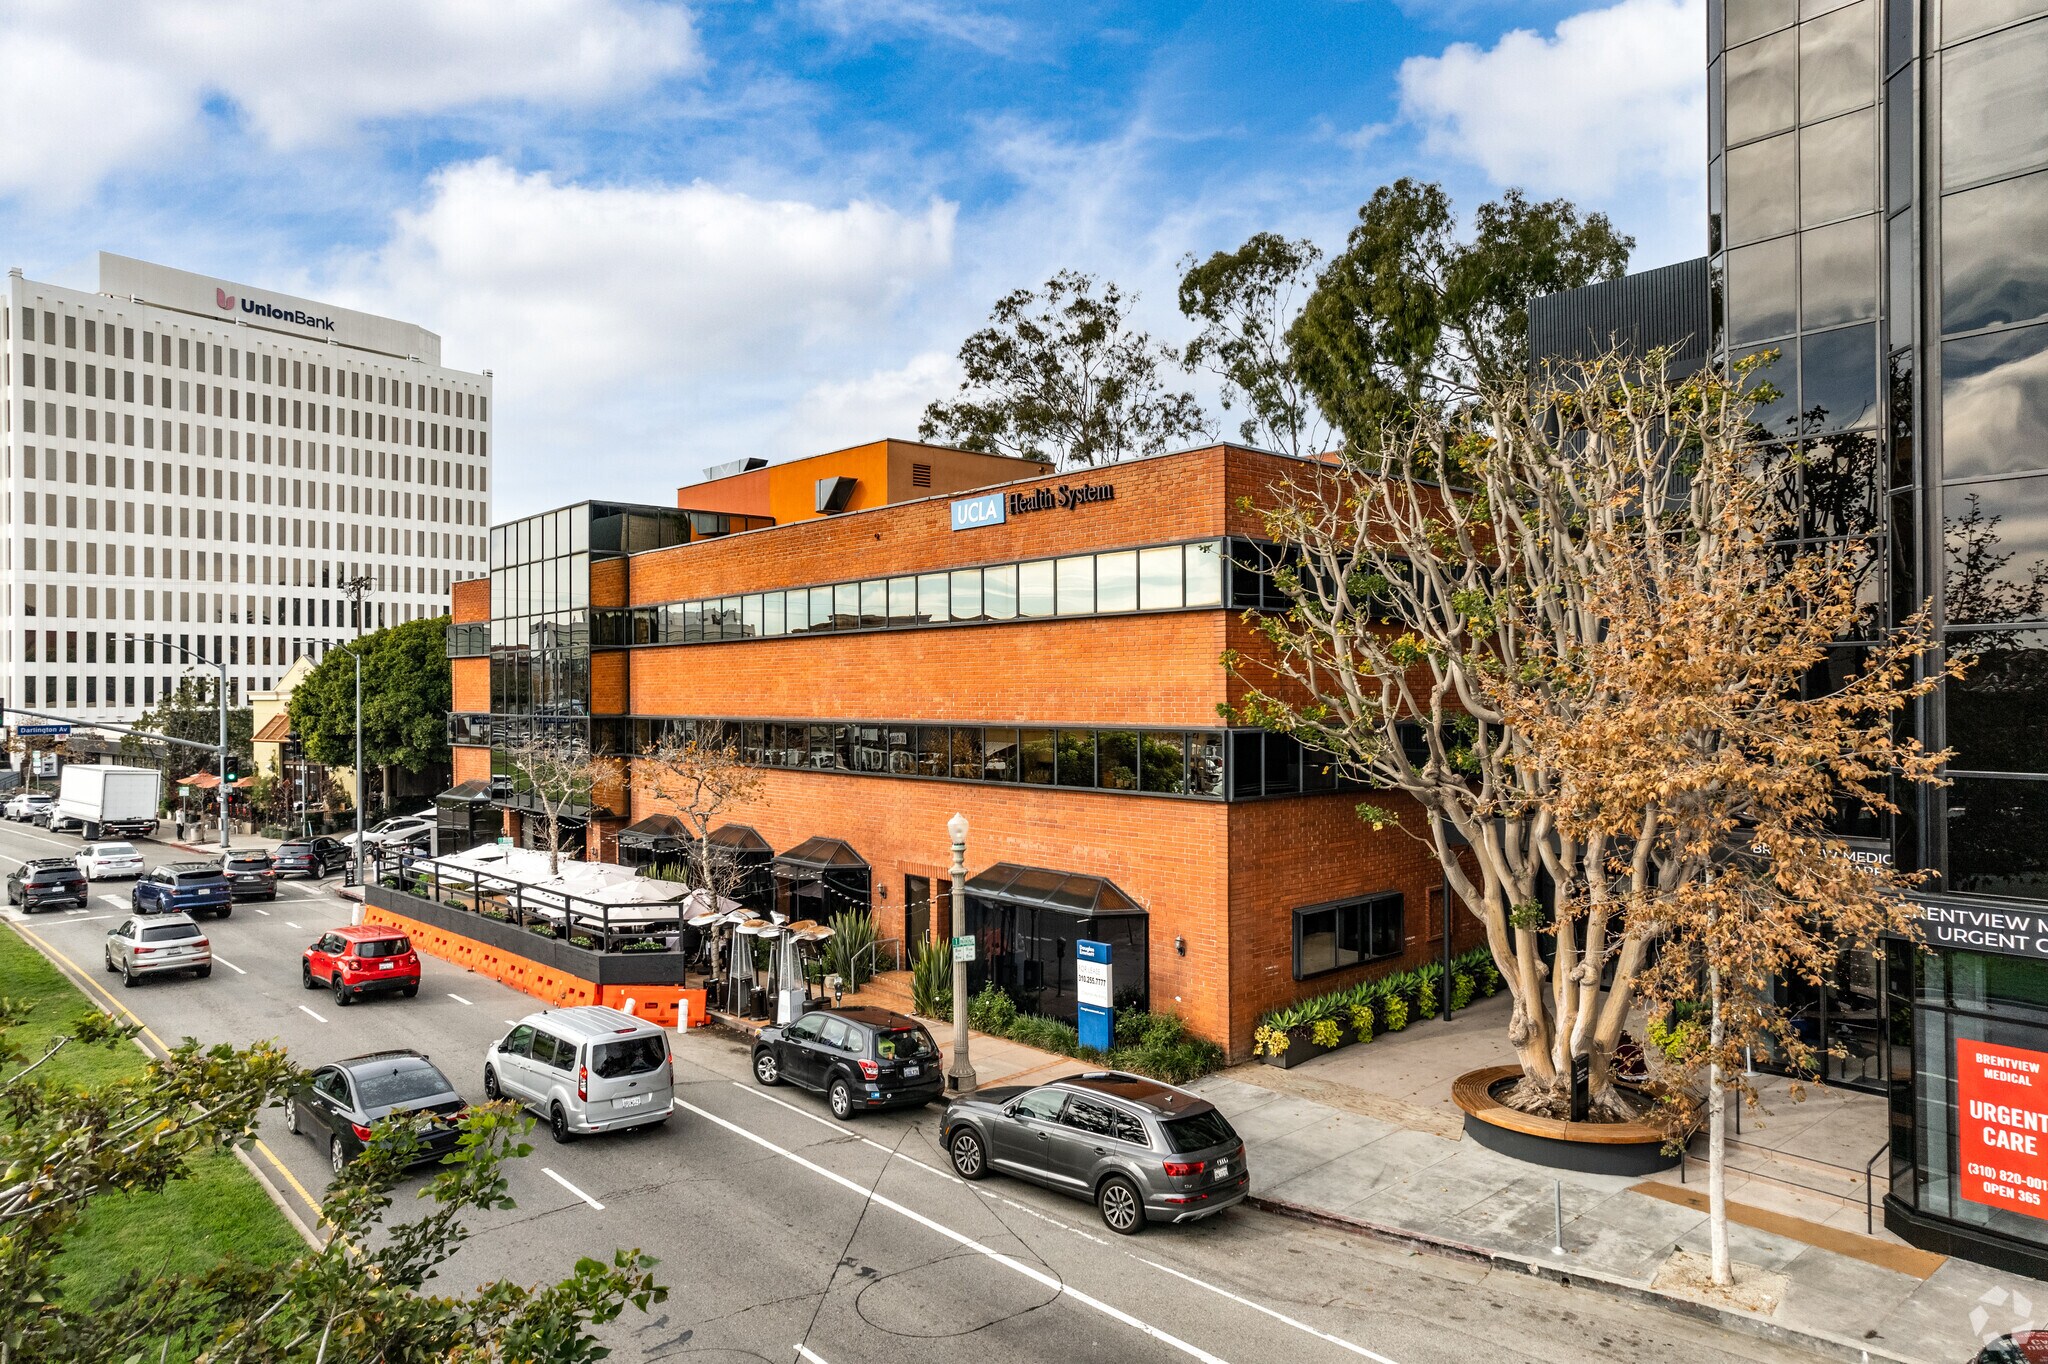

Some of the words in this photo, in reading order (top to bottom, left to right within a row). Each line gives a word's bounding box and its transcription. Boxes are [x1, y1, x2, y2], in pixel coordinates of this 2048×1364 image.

[241, 298, 335, 332] UnionBank
[957, 500, 997, 524] UCLA
[1008, 487, 1054, 514] Health
[1058, 483, 1113, 510] System
[20, 726, 57, 734] Darlington
[1937, 926, 2030, 950] URGENT
[1975, 1052, 2040, 1074] BRENTVIEW
[1983, 1068, 2033, 1087] MEDICAL
[1969, 1099, 2048, 1134] URGENT
[1983, 1126, 2038, 1156] CARE
[1968, 1162, 1997, 1180] (310)
[1999, 1169, 2048, 1192] 820-001
[1983, 1181, 2015, 1199] OPEN
[2018, 1189, 2041, 1206] 365
